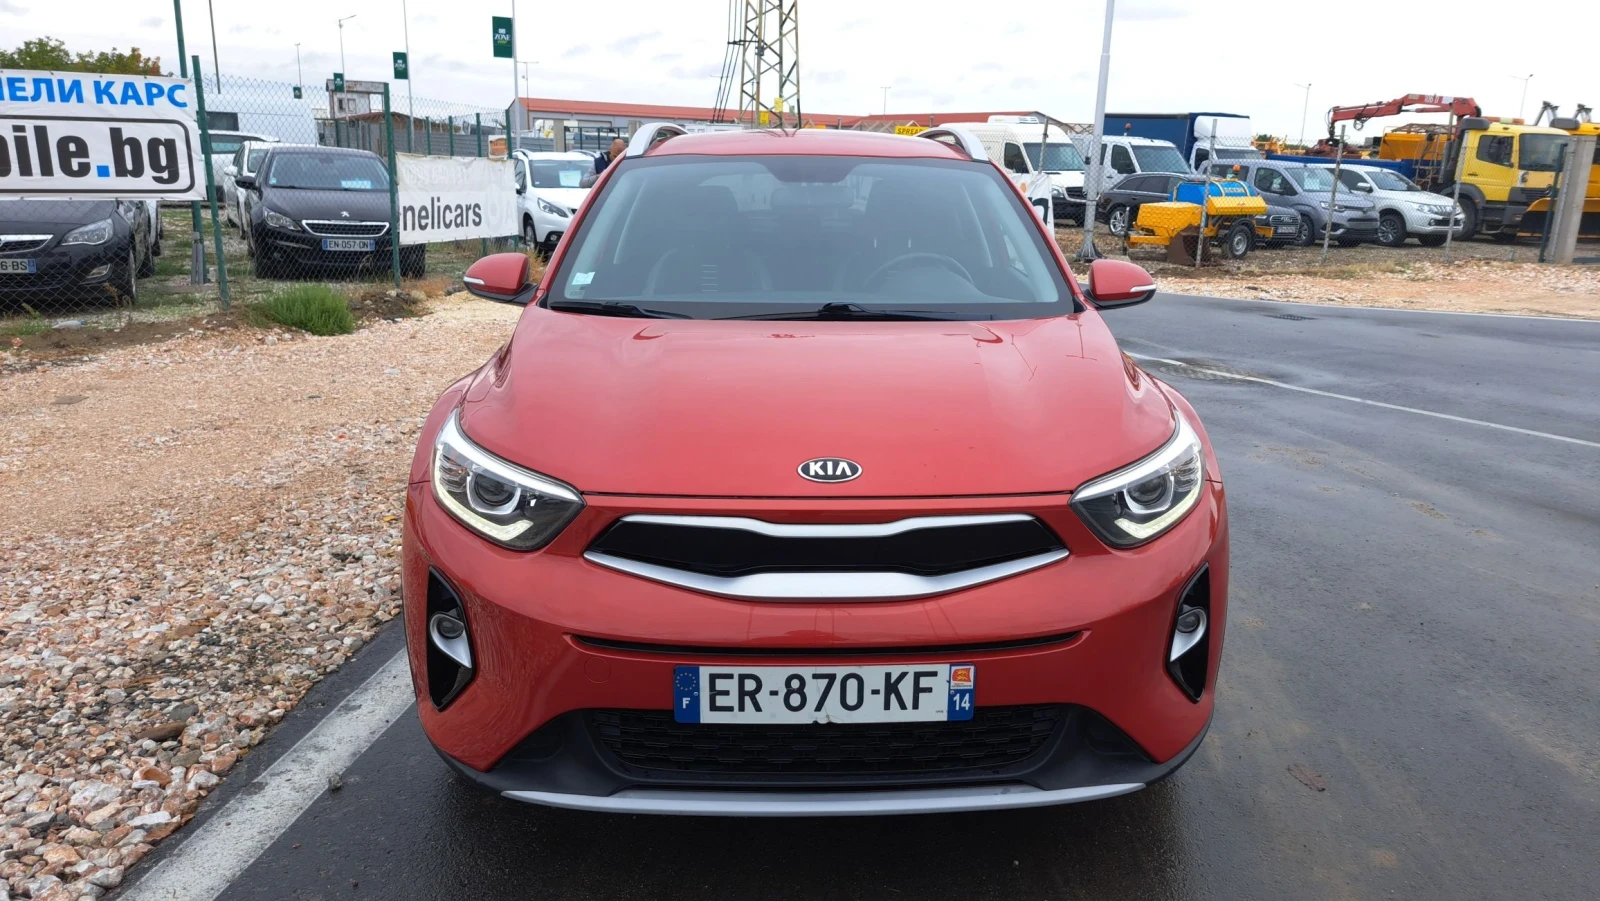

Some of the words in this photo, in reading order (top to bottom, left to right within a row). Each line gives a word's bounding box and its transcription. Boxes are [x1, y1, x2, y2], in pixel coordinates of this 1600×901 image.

[94, 80, 188, 108] КАРС
[402, 196, 482, 231] nelicars
[808, 461, 852, 476] KIA
[682, 697, 691, 709] F
[708, 670, 938, 713] ER-870-KF
[953, 692, 971, 711] 14
